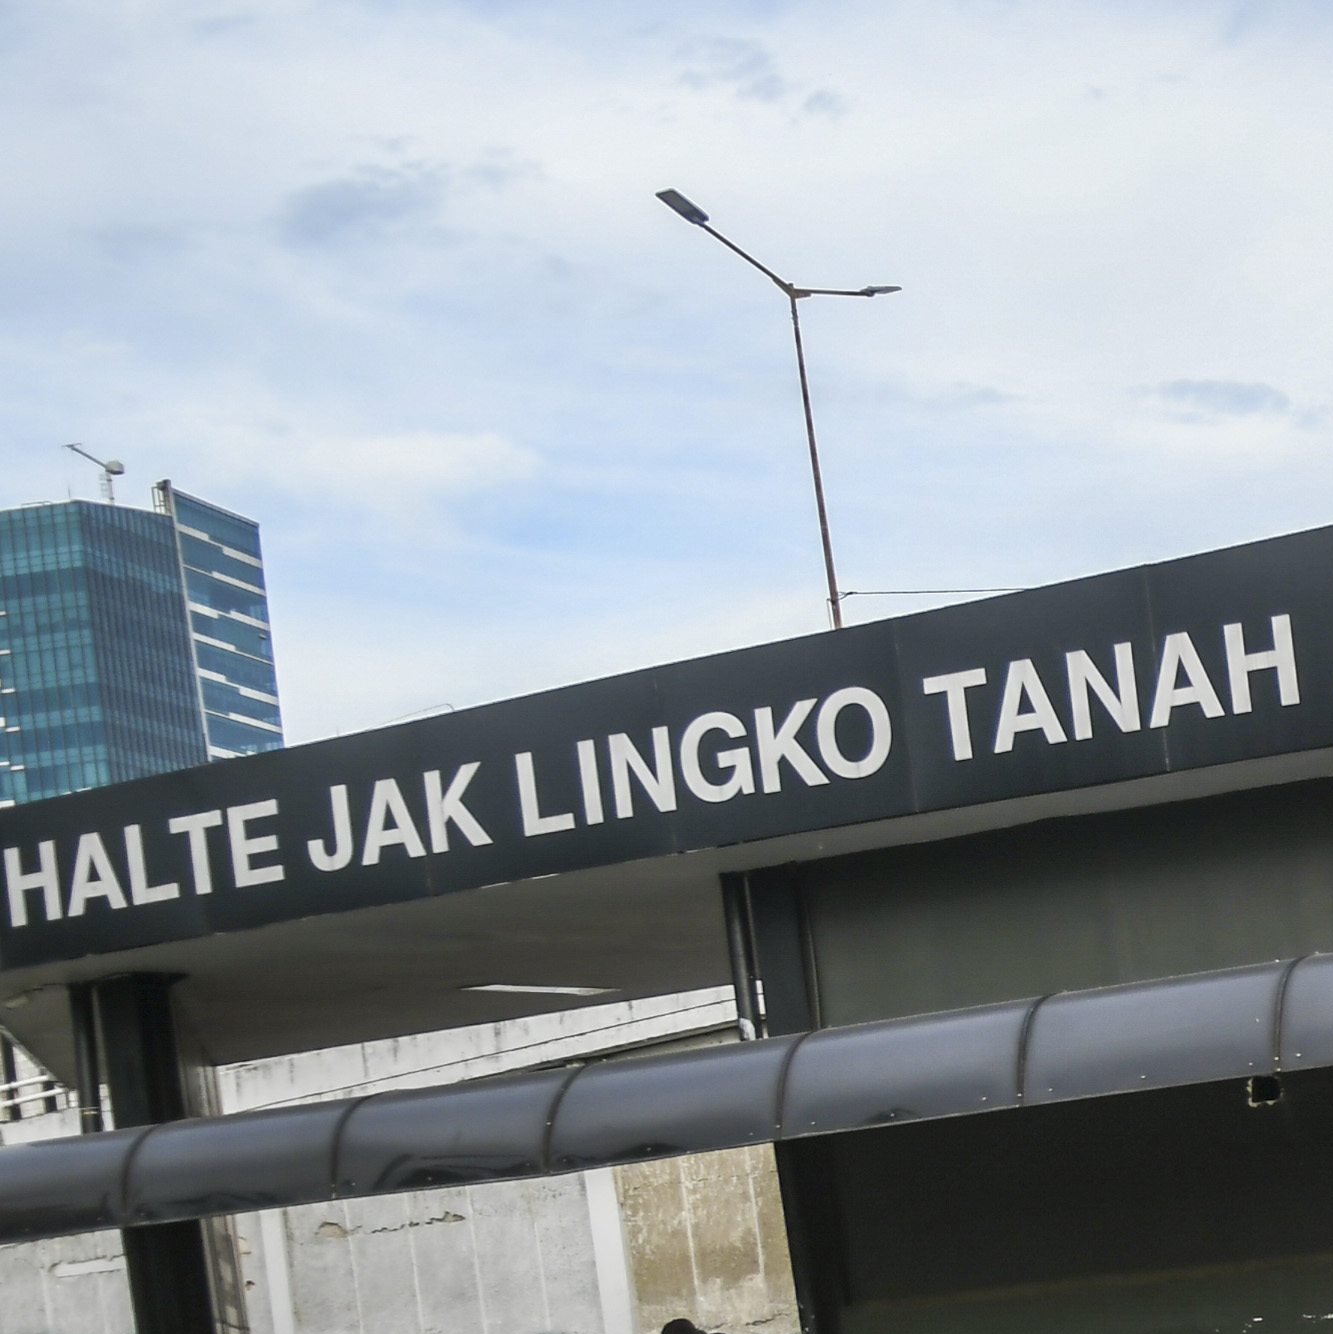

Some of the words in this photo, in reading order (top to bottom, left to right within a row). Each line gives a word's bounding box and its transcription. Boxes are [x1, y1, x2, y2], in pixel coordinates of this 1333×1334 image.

[4, 799, 285, 927] HALTE
[307, 761, 493, 872] JAK
[515, 685, 892, 837] LINGKO
[922, 613, 1300, 761] TANAH
